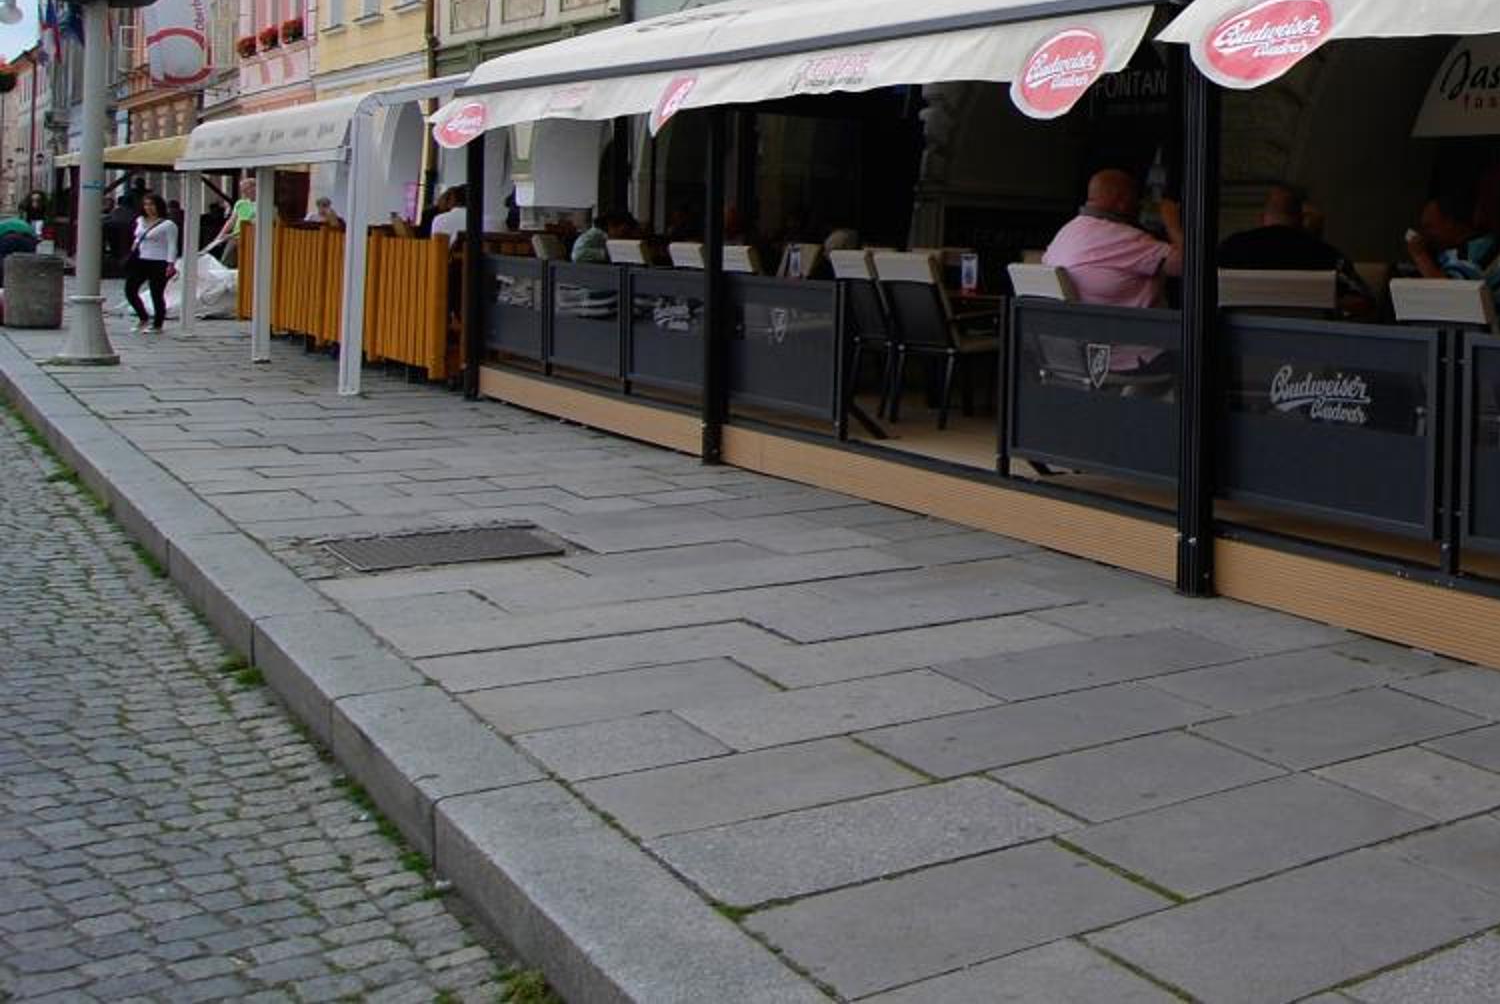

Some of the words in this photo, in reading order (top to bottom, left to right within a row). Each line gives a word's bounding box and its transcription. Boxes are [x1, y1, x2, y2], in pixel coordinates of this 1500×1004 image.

[1212, 13, 1321, 53] Budweiser
[1024, 50, 1097, 89] Budweiser
[1269, 364, 1372, 413] Budweiser
[1309, 396, 1368, 425] Budvar
